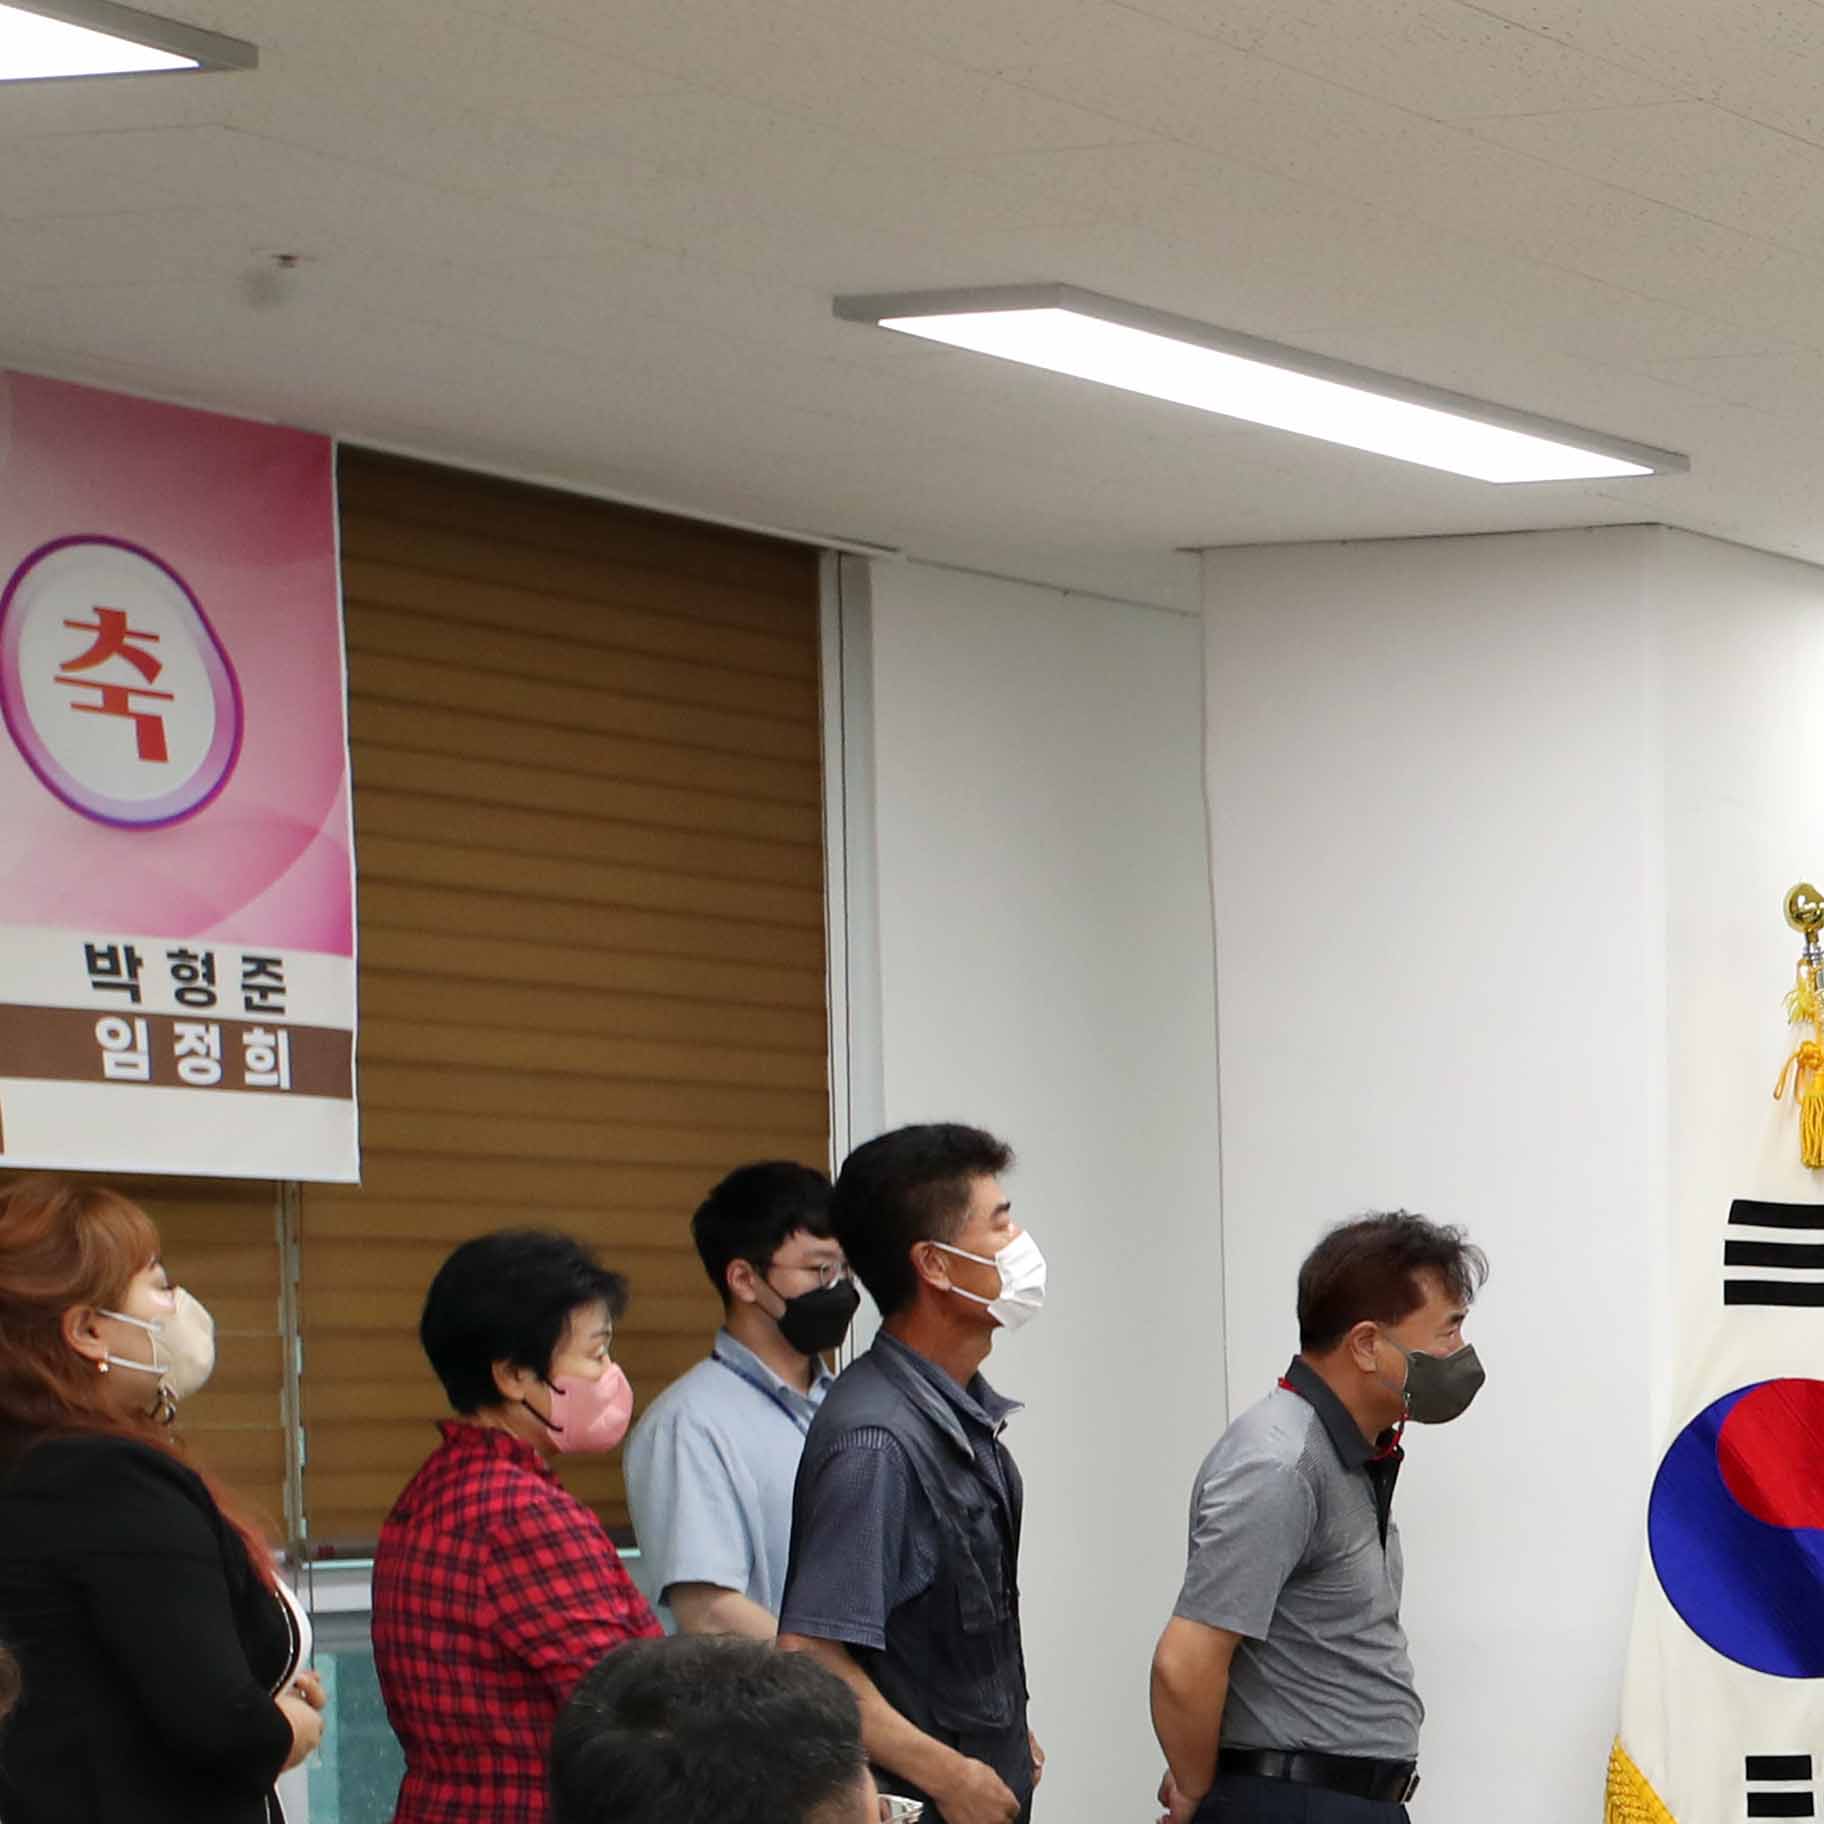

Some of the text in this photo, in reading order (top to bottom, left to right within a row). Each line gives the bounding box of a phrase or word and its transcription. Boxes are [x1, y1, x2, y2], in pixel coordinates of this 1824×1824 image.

[53, 605, 175, 763] 축
[84, 943, 288, 1015] 박형준
[95, 1016, 291, 1090] 임정희
